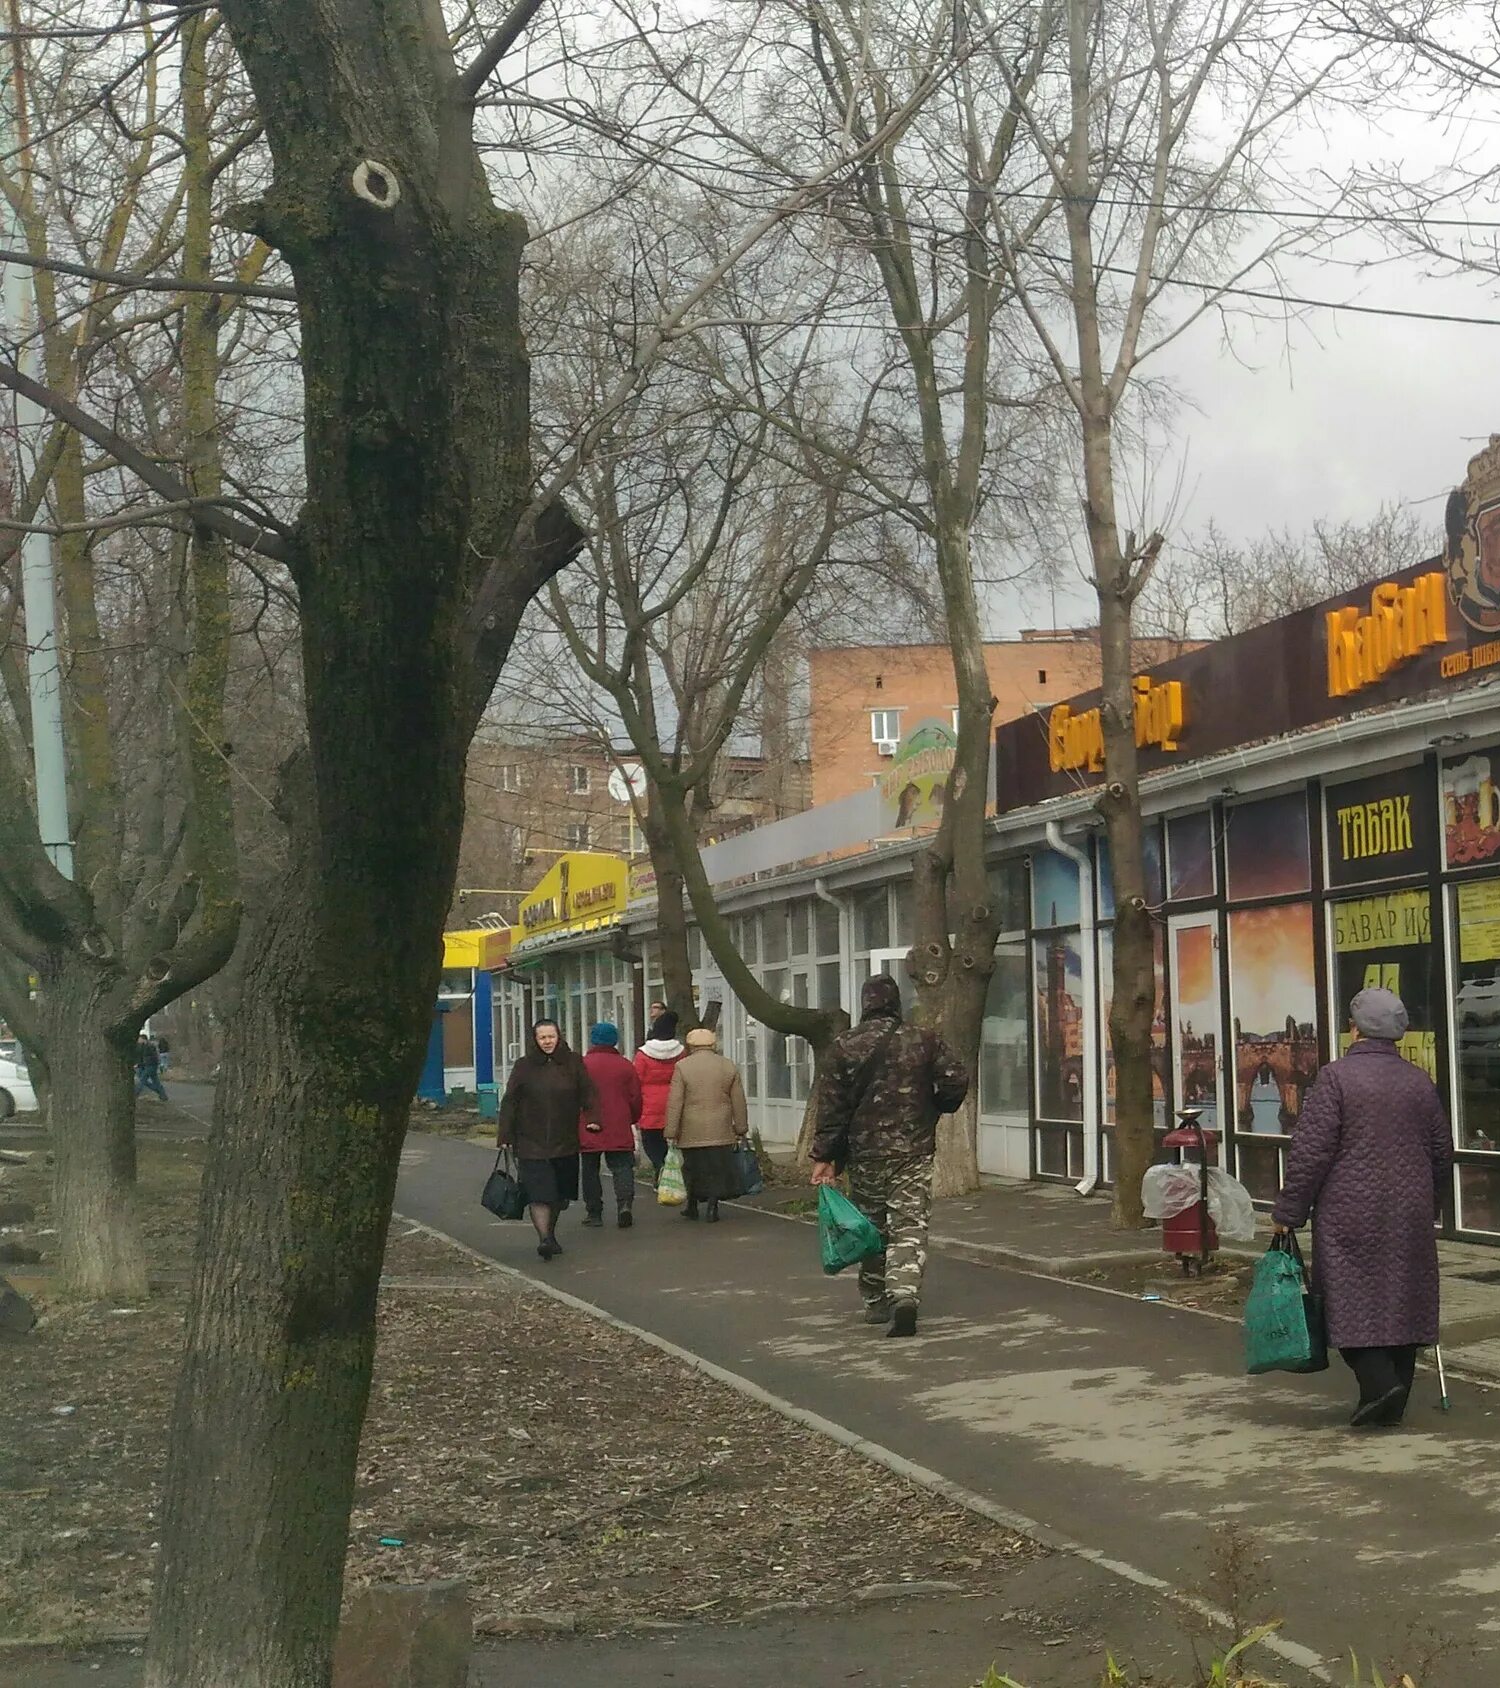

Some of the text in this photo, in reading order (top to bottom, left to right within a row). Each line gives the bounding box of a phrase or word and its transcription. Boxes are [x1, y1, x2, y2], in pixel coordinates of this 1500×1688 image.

[1326, 572, 1448, 697] Кабан
[1440, 652, 1472, 678] сеть
[1337, 795, 1412, 860] ТАБАК
